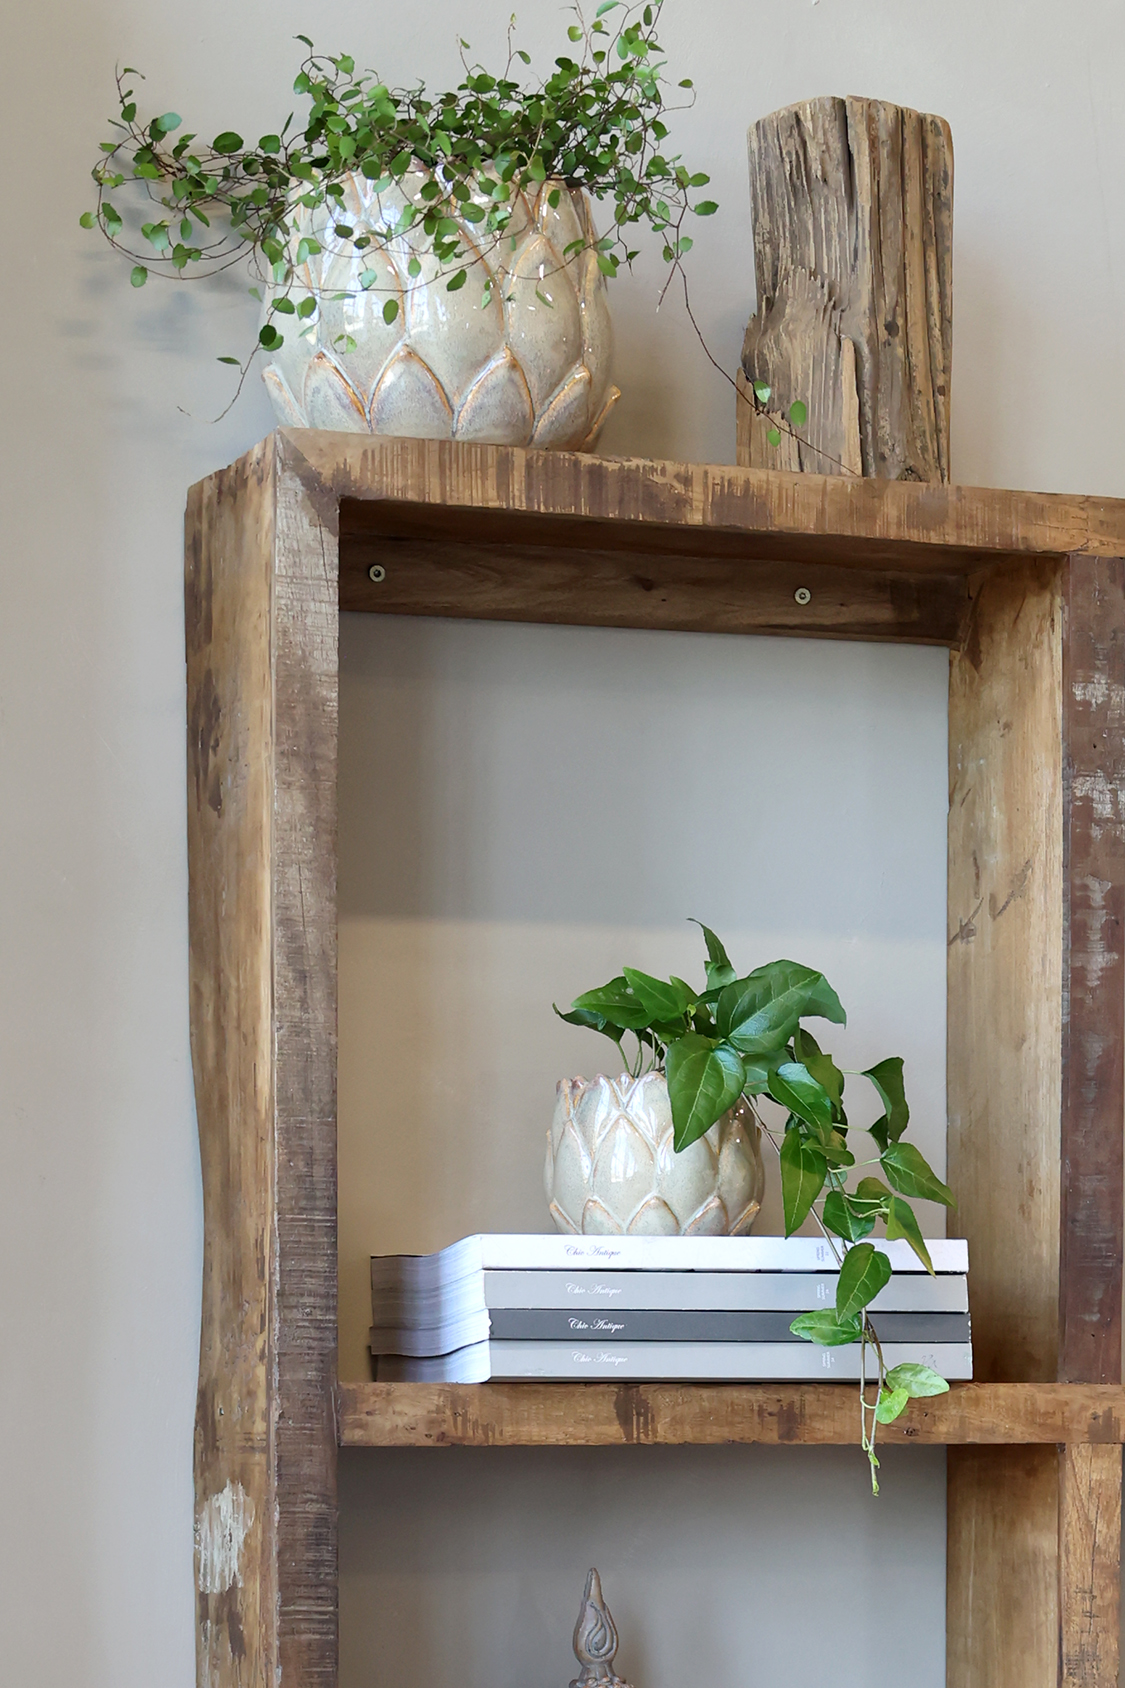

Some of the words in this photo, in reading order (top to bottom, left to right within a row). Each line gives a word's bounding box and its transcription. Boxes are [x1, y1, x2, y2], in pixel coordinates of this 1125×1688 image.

[564, 1244, 585, 1256] Chic
[586, 1245, 621, 1259] Antique
[565, 1282, 586, 1294] Chic
[587, 1283, 622, 1297] Antique
[568, 1317, 589, 1330] Chic
[590, 1318, 625, 1333] Antique
[571, 1351, 592, 1363] Chic
[593, 1351, 628, 1366] Antique
